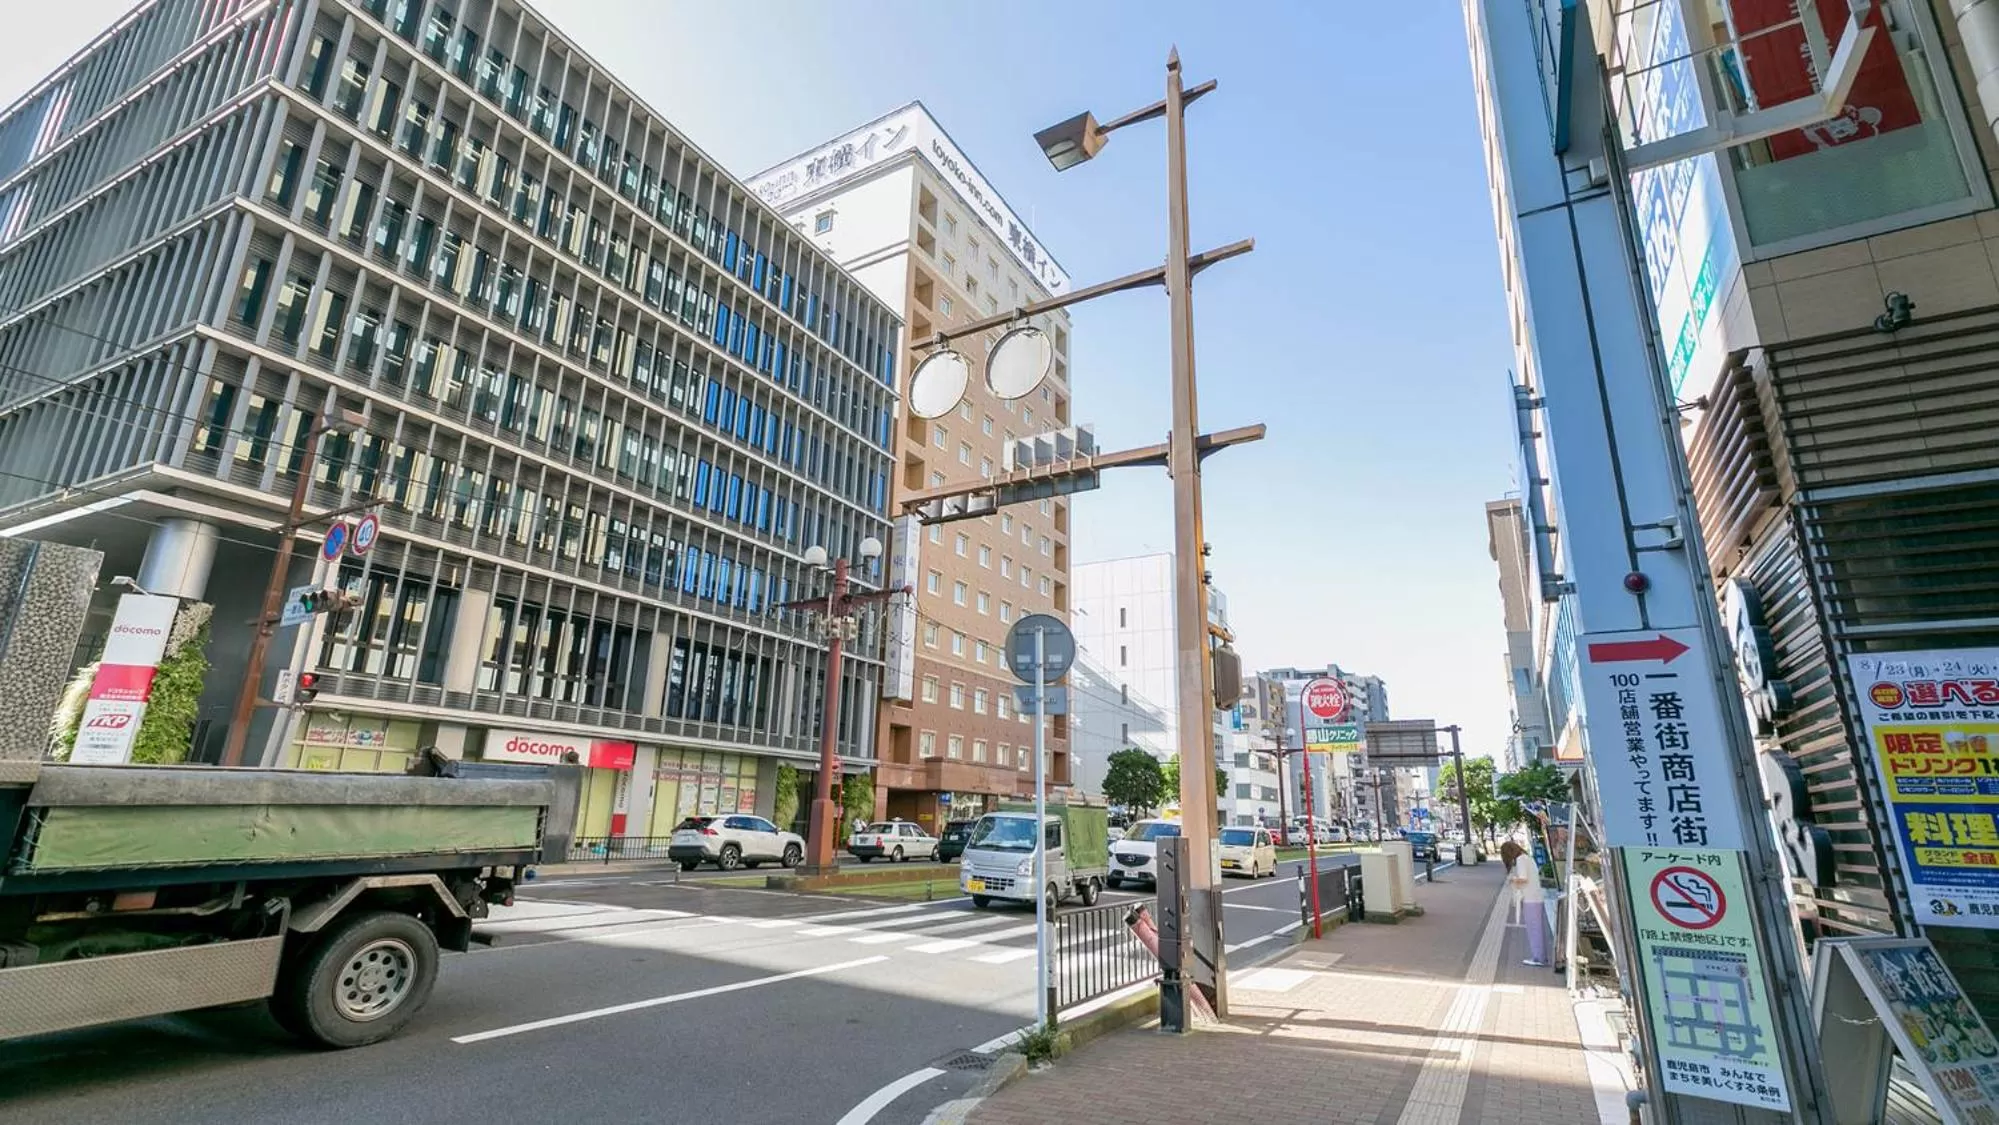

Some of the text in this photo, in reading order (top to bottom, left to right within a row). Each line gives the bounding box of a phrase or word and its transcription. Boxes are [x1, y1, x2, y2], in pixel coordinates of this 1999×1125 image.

[932, 138, 1004, 229] toyoko-inn.com
[1007, 218, 1062, 288] 東横イン
[358, 523, 374, 543] 40
[113, 624, 162, 636] docomo
[1310, 693, 1341, 707] 消火栓
[1905, 679, 1999, 706] 選べる
[91, 714, 128, 728] TKP
[1879, 710, 1999, 722] ご希望の割引を下記
[1884, 733, 1944, 754] 限定
[1645, 673, 1709, 847] 一番街商店街
[1904, 811, 1999, 846] 料理
[1641, 852, 1721, 866] アーケード内
[1666, 1059, 1711, 1074] 鹿児島市
[1720, 1066, 1766, 1083] みんなで
[1669, 1071, 1782, 1098] まちを美しくする条例
